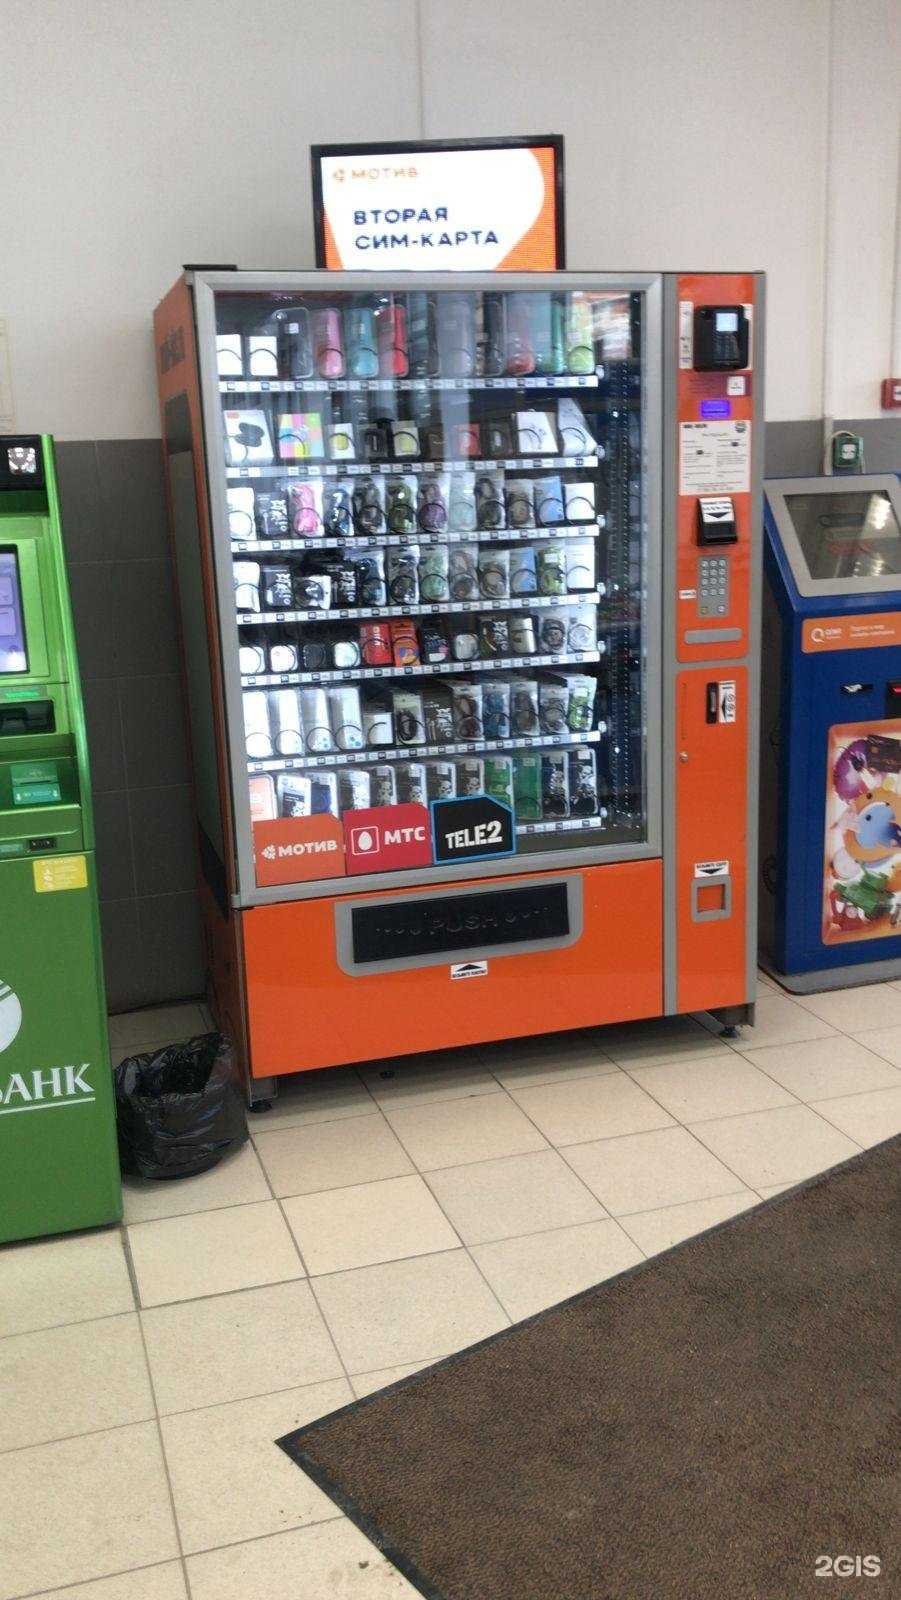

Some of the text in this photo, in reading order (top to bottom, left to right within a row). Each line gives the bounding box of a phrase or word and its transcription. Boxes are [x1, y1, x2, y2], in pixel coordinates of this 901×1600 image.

[352, 167, 419, 179] МОТИВ
[354, 207, 448, 226] ВТОРАЯ
[355, 230, 499, 250] СИМ-КАРТА
[384, 826, 426, 846] МТС
[444, 819, 503, 850] TELE2
[278, 839, 338, 858] МОТИВ
[0, 1063, 94, 1105] АНК
